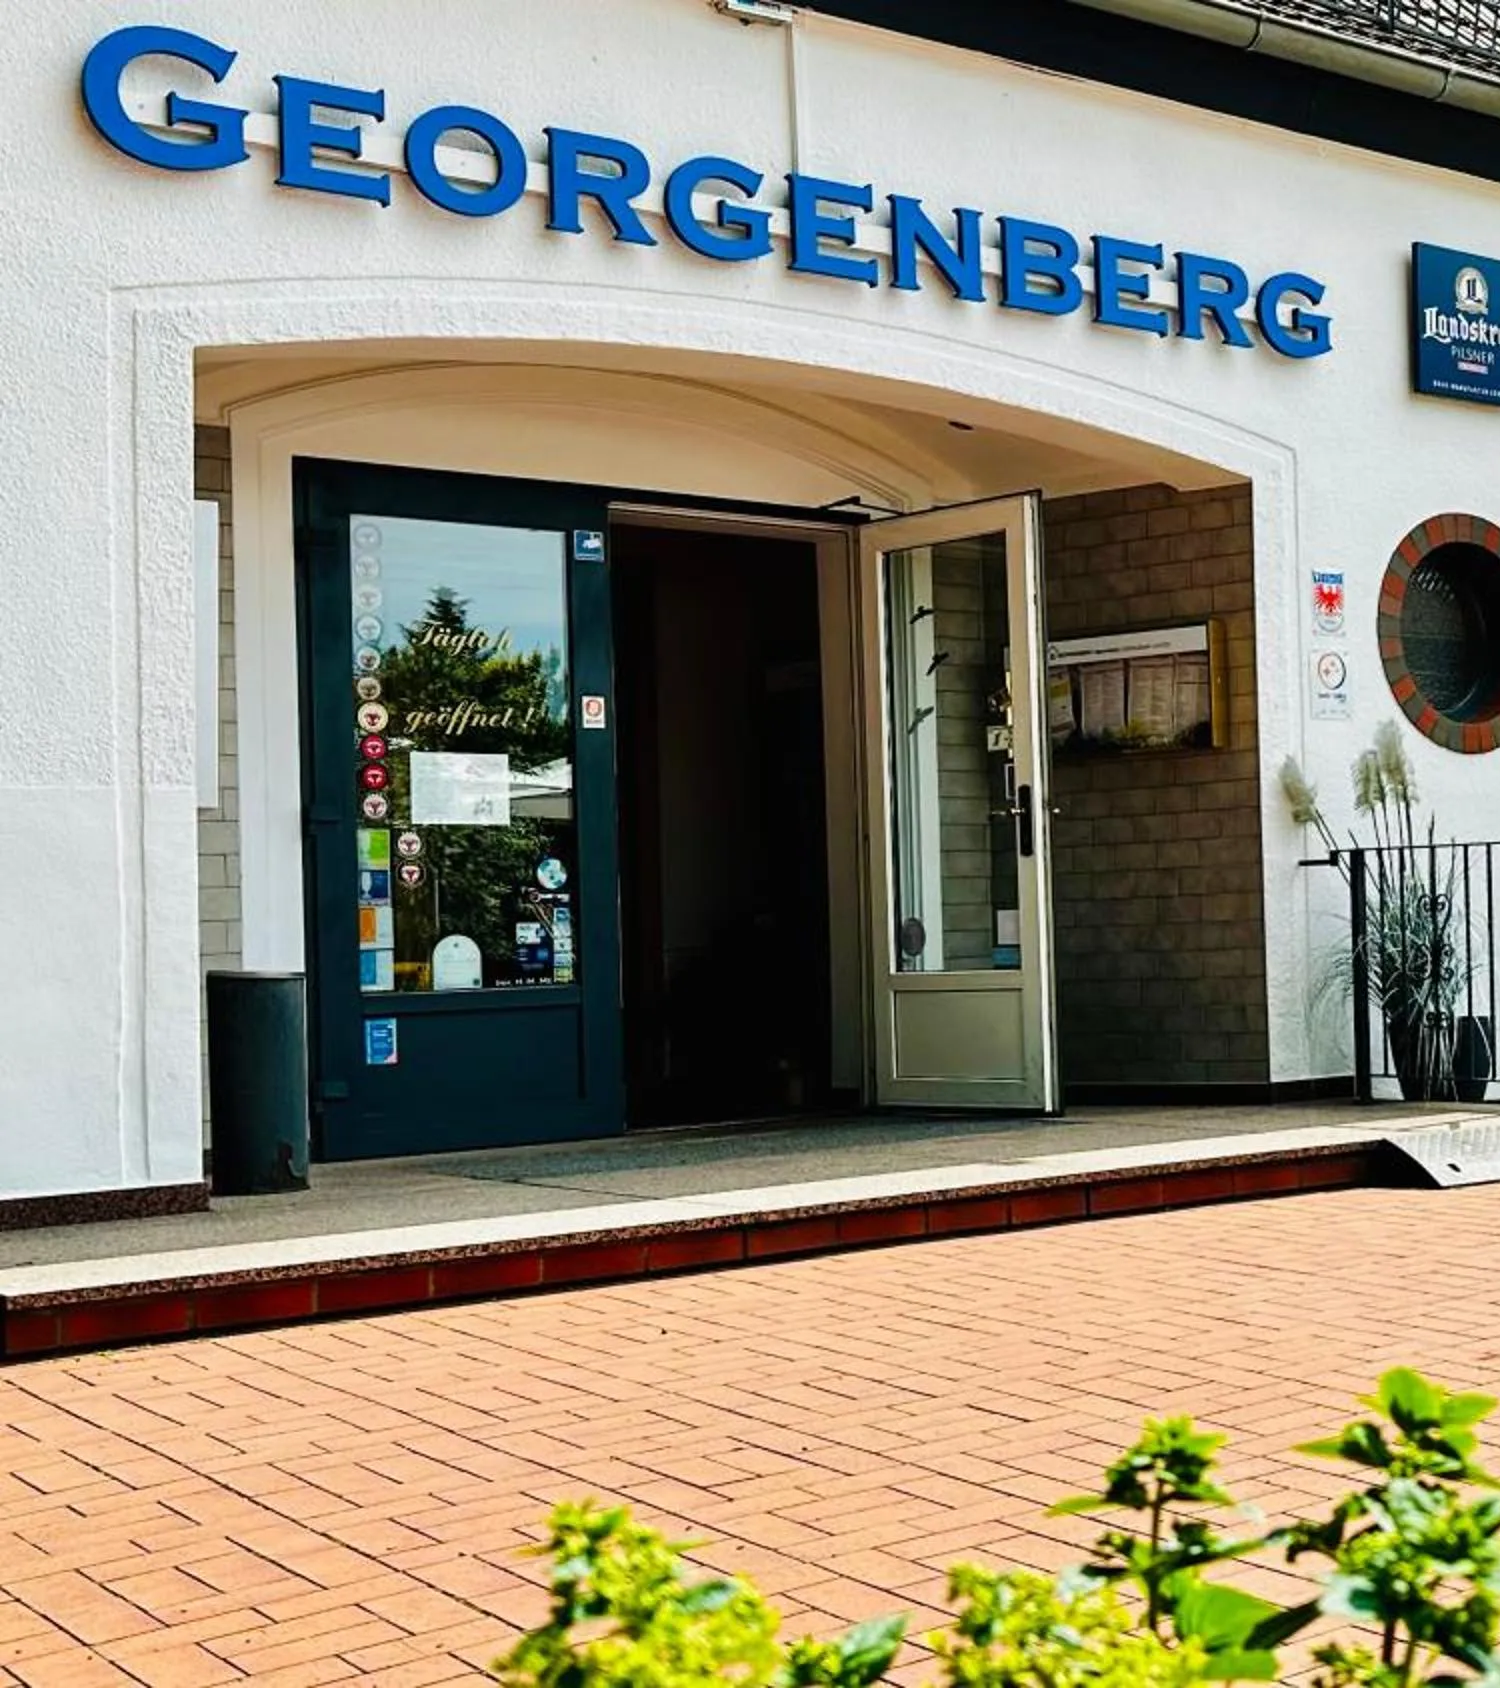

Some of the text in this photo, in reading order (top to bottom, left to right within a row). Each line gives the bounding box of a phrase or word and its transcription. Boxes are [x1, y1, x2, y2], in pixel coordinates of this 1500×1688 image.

[82, 25, 1333, 358] GEORGENBERG
[1451, 345, 1495, 365] PILSNER
[403, 699, 514, 735] geöffnet
